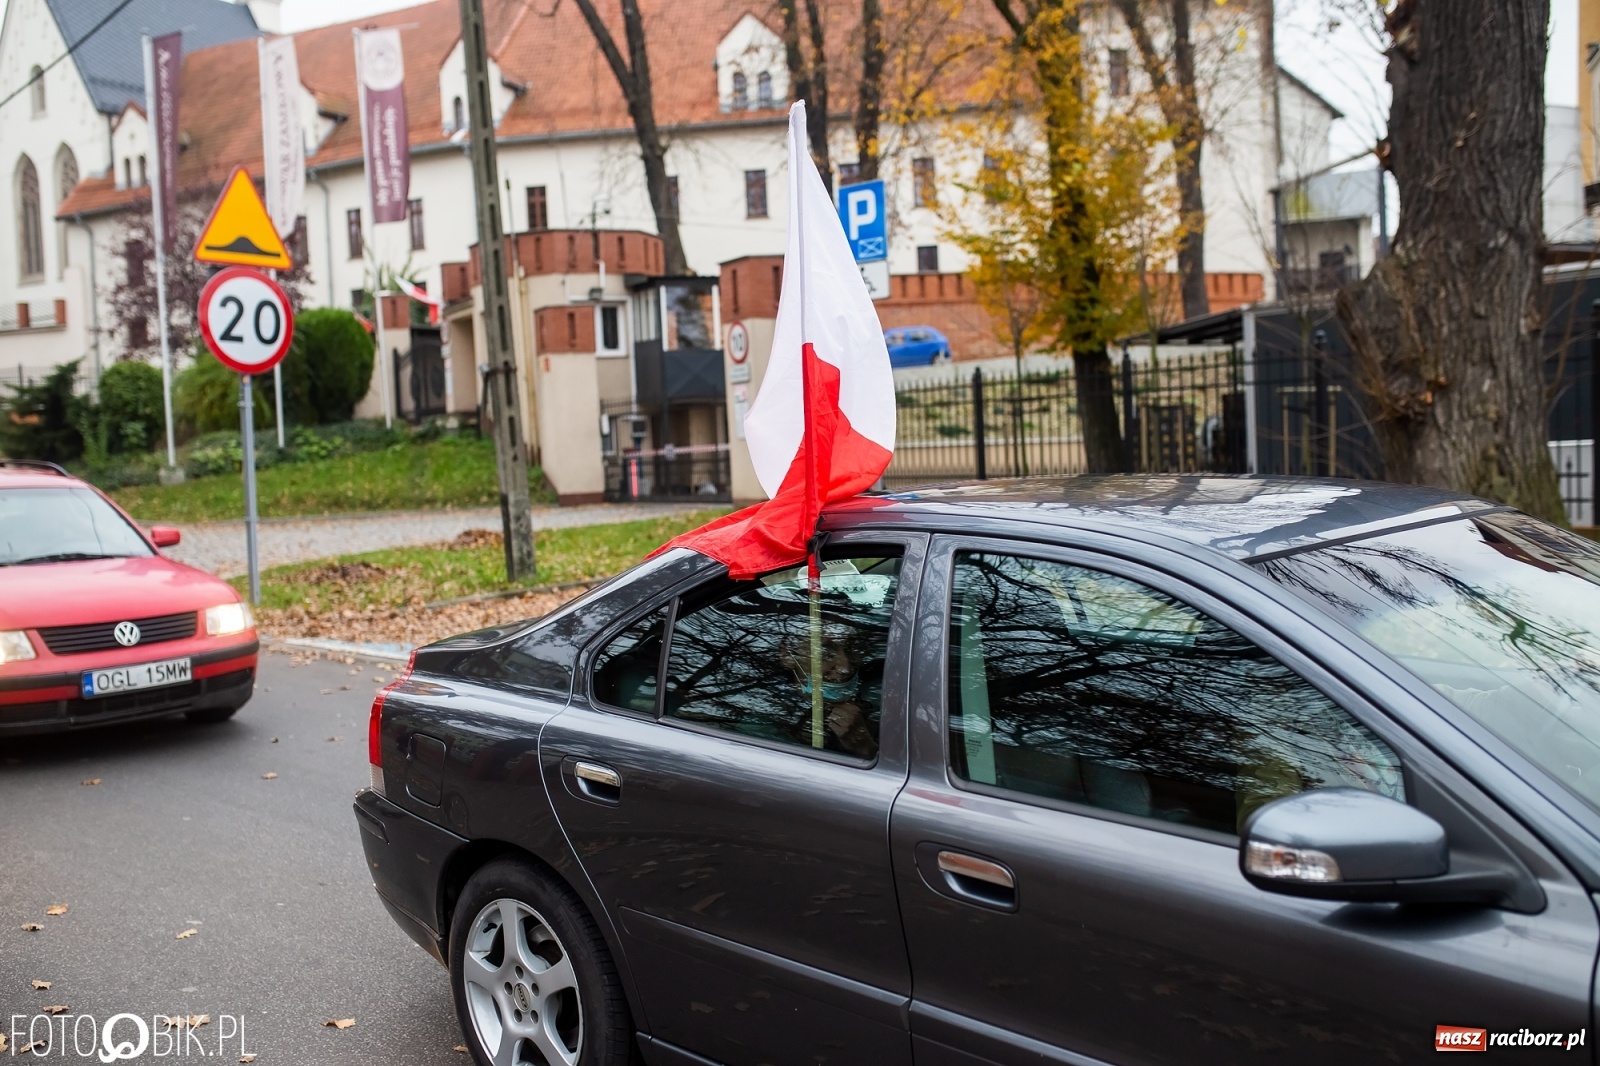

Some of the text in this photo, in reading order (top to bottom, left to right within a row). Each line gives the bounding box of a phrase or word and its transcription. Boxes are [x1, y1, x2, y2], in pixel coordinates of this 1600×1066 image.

[848, 189, 876, 240] P
[219, 295, 281, 345] 20
[97, 662, 187, 691] OGL 15MW
